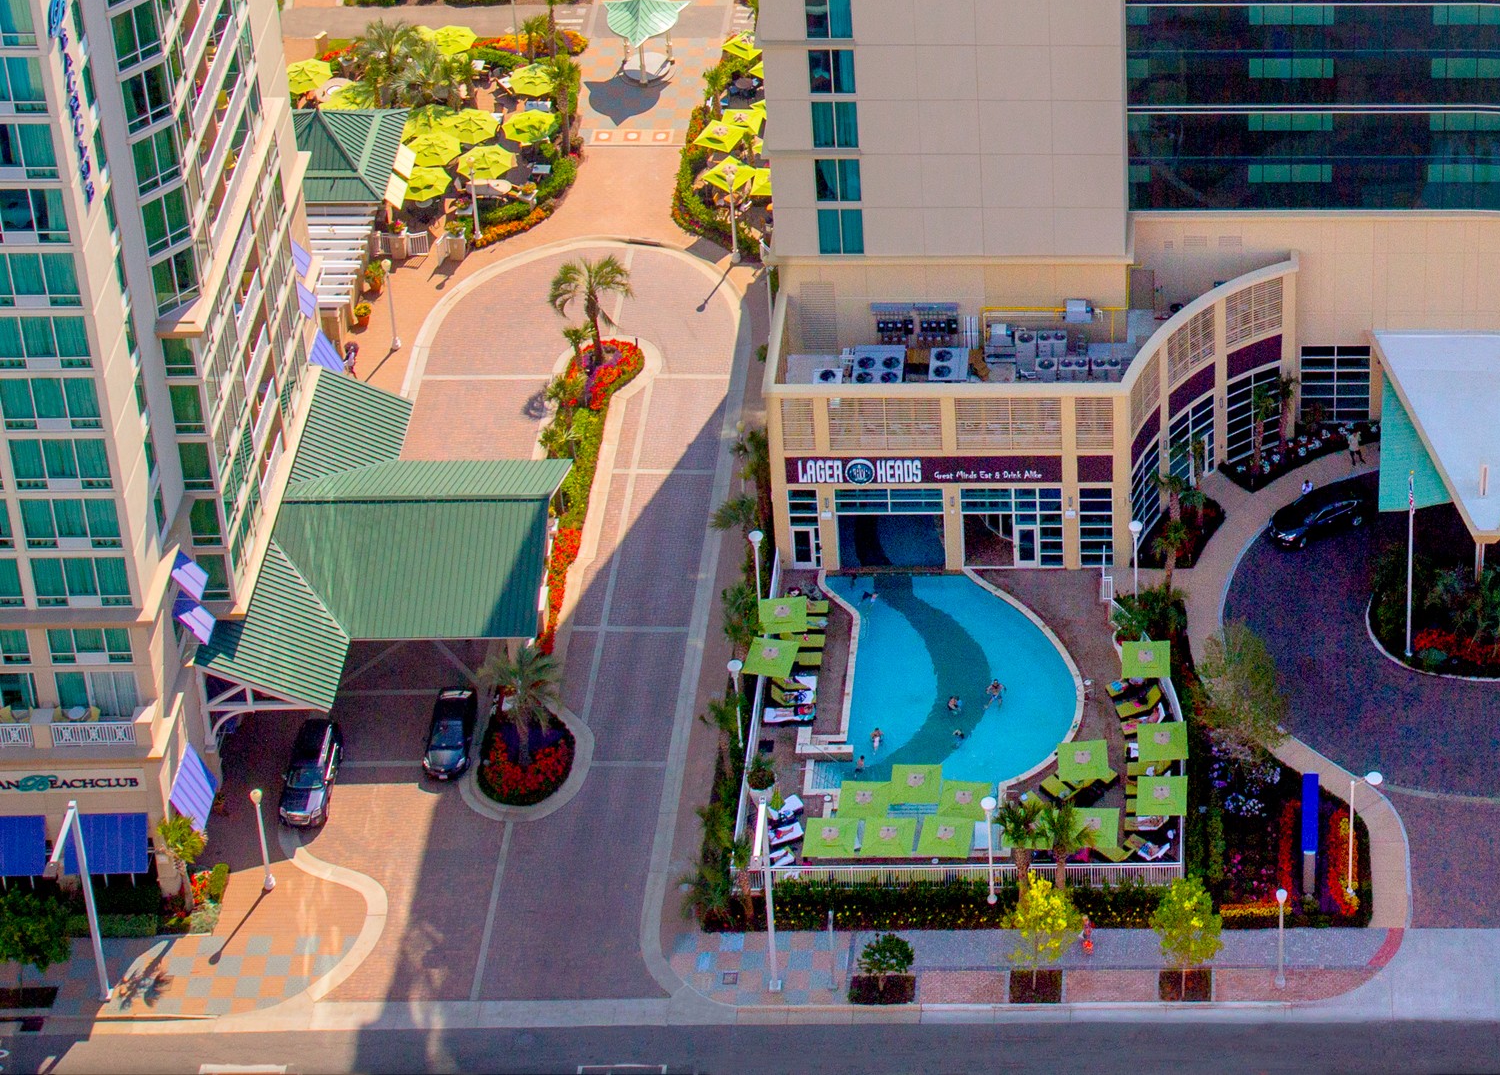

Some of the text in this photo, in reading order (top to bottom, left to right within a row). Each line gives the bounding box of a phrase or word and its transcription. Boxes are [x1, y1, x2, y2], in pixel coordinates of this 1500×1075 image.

[798, 460, 844, 483] LAGER
[876, 459, 922, 483] HEADS
[933, 471, 953, 480] Great
[956, 470, 977, 479] Minds
[979, 471, 992, 479] Eat
[1003, 470, 1021, 479] Drink
